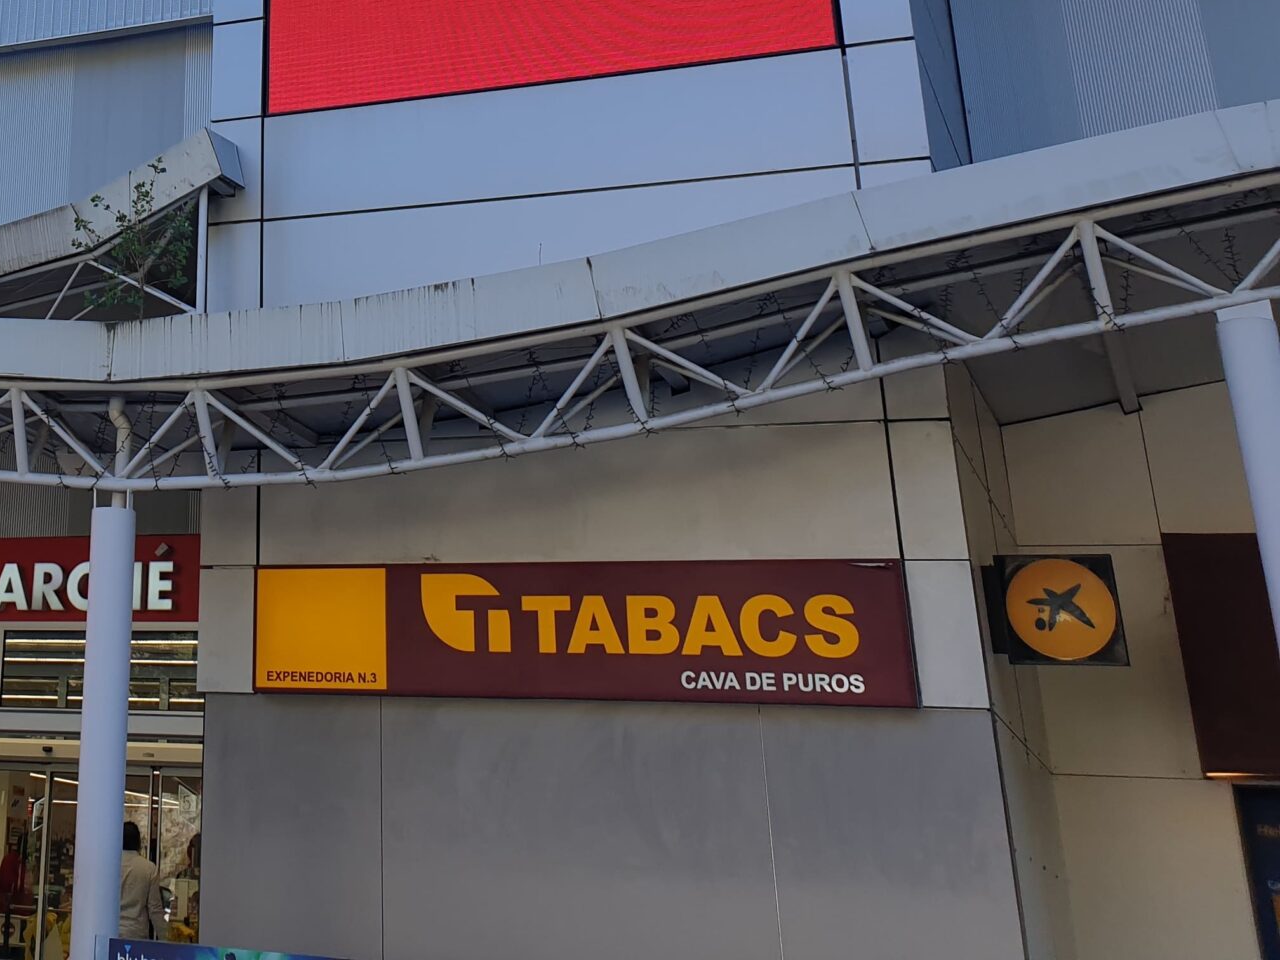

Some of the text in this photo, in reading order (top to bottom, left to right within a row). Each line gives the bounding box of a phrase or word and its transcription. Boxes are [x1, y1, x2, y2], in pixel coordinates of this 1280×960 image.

[520, 593, 861, 659] TABACS
[266, 670, 378, 684] EXPENEDORIA N.3
[680, 670, 866, 695] CAVA DE PUROS
